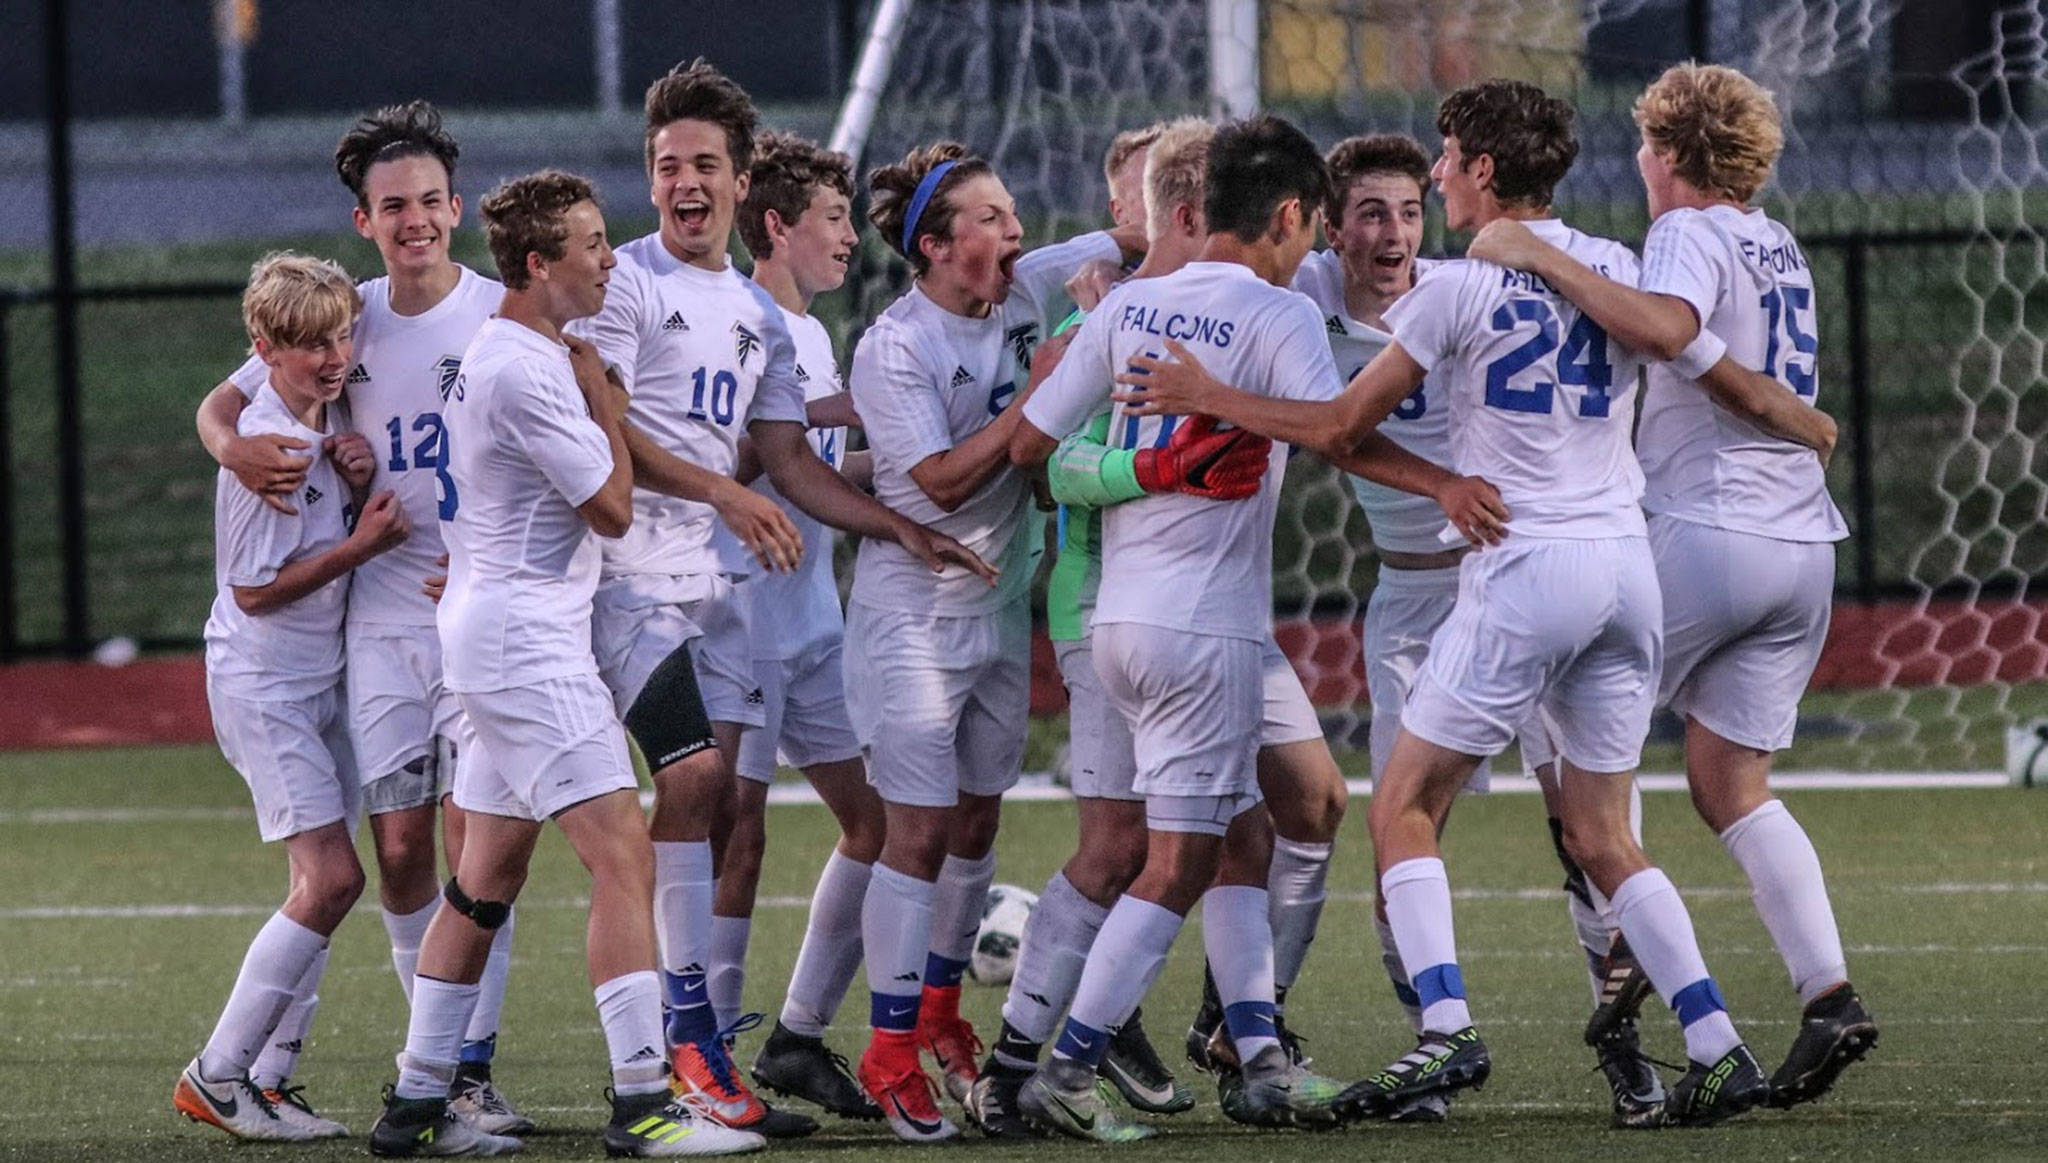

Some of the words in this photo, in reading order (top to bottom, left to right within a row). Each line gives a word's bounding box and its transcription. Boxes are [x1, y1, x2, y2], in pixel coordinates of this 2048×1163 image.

[1484, 300, 1612, 418] 24
[1760, 287, 1818, 397] 15
[687, 366, 738, 426] 10
[386, 412, 444, 472] 12
